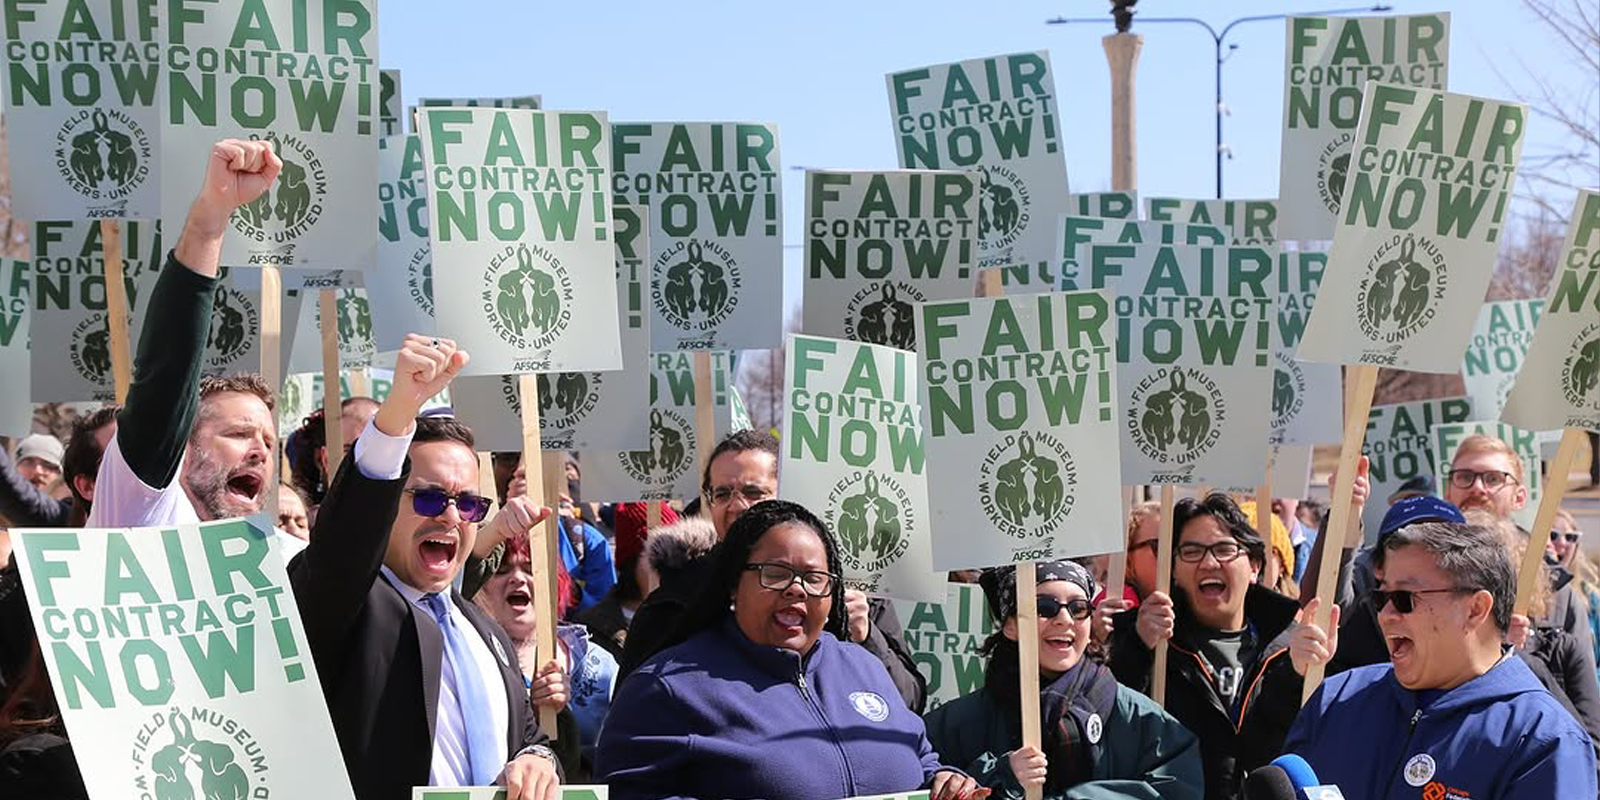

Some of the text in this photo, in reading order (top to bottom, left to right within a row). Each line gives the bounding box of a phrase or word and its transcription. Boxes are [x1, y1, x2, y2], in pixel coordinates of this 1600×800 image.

[168, 0, 372, 57] FAIR
[1291, 14, 1445, 66] FAIR
[6, 41, 160, 63] CONTRAC
[167, 45, 374, 84] CONTRACT
[10, 62, 160, 107] NOW
[892, 52, 1047, 116] FAIR
[1290, 63, 1445, 86] CONTRACT
[169, 71, 372, 135] NOW!
[899, 94, 1052, 134] CONTRACT
[1288, 86, 1364, 129] NO
[1364, 85, 1524, 165] FAIR
[57, 108, 151, 159] FIELD MUSEUM
[427, 110, 602, 168] FAIR
[611, 124, 775, 173] FAIR
[901, 114, 1058, 170] NOW!
[1321, 133, 1349, 164] FIELD
[55, 148, 149, 201] WORKERS UNITED
[283, 134, 327, 195] MUSEUM
[433, 166, 605, 192] CONTRACT
[612, 172, 778, 194] CONTRACT
[990, 164, 1031, 208] MUSEUM
[1357, 145, 1515, 190] CONTRACT
[86, 209, 128, 219] AFSCME
[810, 173, 975, 219] FAIR
[1317, 169, 1340, 216] WORKE
[1345, 172, 1508, 243] NOW!
[229, 206, 323, 244] KERS UNITED
[379, 198, 429, 242] NO
[436, 190, 607, 242] NOW!
[613, 194, 777, 238] OW!
[810, 218, 974, 239] CONTRACT
[998, 213, 1031, 250] UNITED
[36, 220, 138, 261] FAI
[248, 253, 294, 266] AFSCME
[410, 247, 431, 277] FIEL
[809, 238, 971, 280] NOW!
[303, 278, 342, 288] AFSCME
[484, 245, 574, 302] FIELD MUSEUM
[654, 239, 742, 290] FIELD MUSEUM
[1091, 245, 1273, 298] FAIR
[1279, 252, 1329, 293] IR
[1368, 233, 1446, 301] FIELD MUSEUM
[36, 274, 138, 312] NO
[229, 288, 257, 337] MUSEUM
[410, 278, 436, 318] WORKE
[651, 278, 739, 331] WORKERS UNITED
[848, 281, 928, 312] FIELD MUS
[1115, 295, 1273, 320] ONTRACT
[1356, 278, 1380, 342] WORKERS
[1386, 307, 1436, 344] UNITED
[482, 291, 572, 350] WORKERS UNITED
[923, 291, 1109, 361] FAIR
[1571, 322, 1600, 351] FIEL
[211, 342, 252, 366] UNITED
[513, 361, 551, 371] AFSCME
[677, 341, 716, 350] AFSCME
[926, 346, 1111, 386] CONTRACT
[1358, 353, 1399, 366] AFSCME
[1464, 344, 1527, 376] NO
[793, 336, 921, 406] FAI
[1562, 356, 1585, 408] WORKERS
[556, 393, 600, 429] UNITED
[790, 388, 923, 430] CONTRA
[928, 371, 1112, 438] NOW!
[1131, 367, 1226, 422] FIELD MUSEUM
[541, 440, 574, 449] FSCME
[663, 409, 696, 450] MUSEUM
[790, 411, 925, 476] NOW
[1127, 407, 1221, 465] WORKERS UNITED
[1363, 434, 1428, 455] CONTR
[618, 450, 695, 486] ORKERS UNITED
[981, 430, 1078, 485] FIELD MUSEUM
[1151, 474, 1194, 484] AFSCME
[1367, 448, 1436, 483] NO
[828, 470, 915, 532] FIELD MUSEUM
[978, 482, 1076, 539] WORKERS UNITED
[22, 520, 275, 607] FAIR
[867, 539, 910, 572] UNITED
[1012, 549, 1054, 563] AFSCME
[848, 581, 879, 593] FSCME
[42, 586, 285, 640] CONTRACT
[908, 586, 993, 635] AI
[51, 616, 306, 710] NOW!
[911, 652, 987, 697] OW
[132, 706, 269, 775] FIELD MUSEUM
